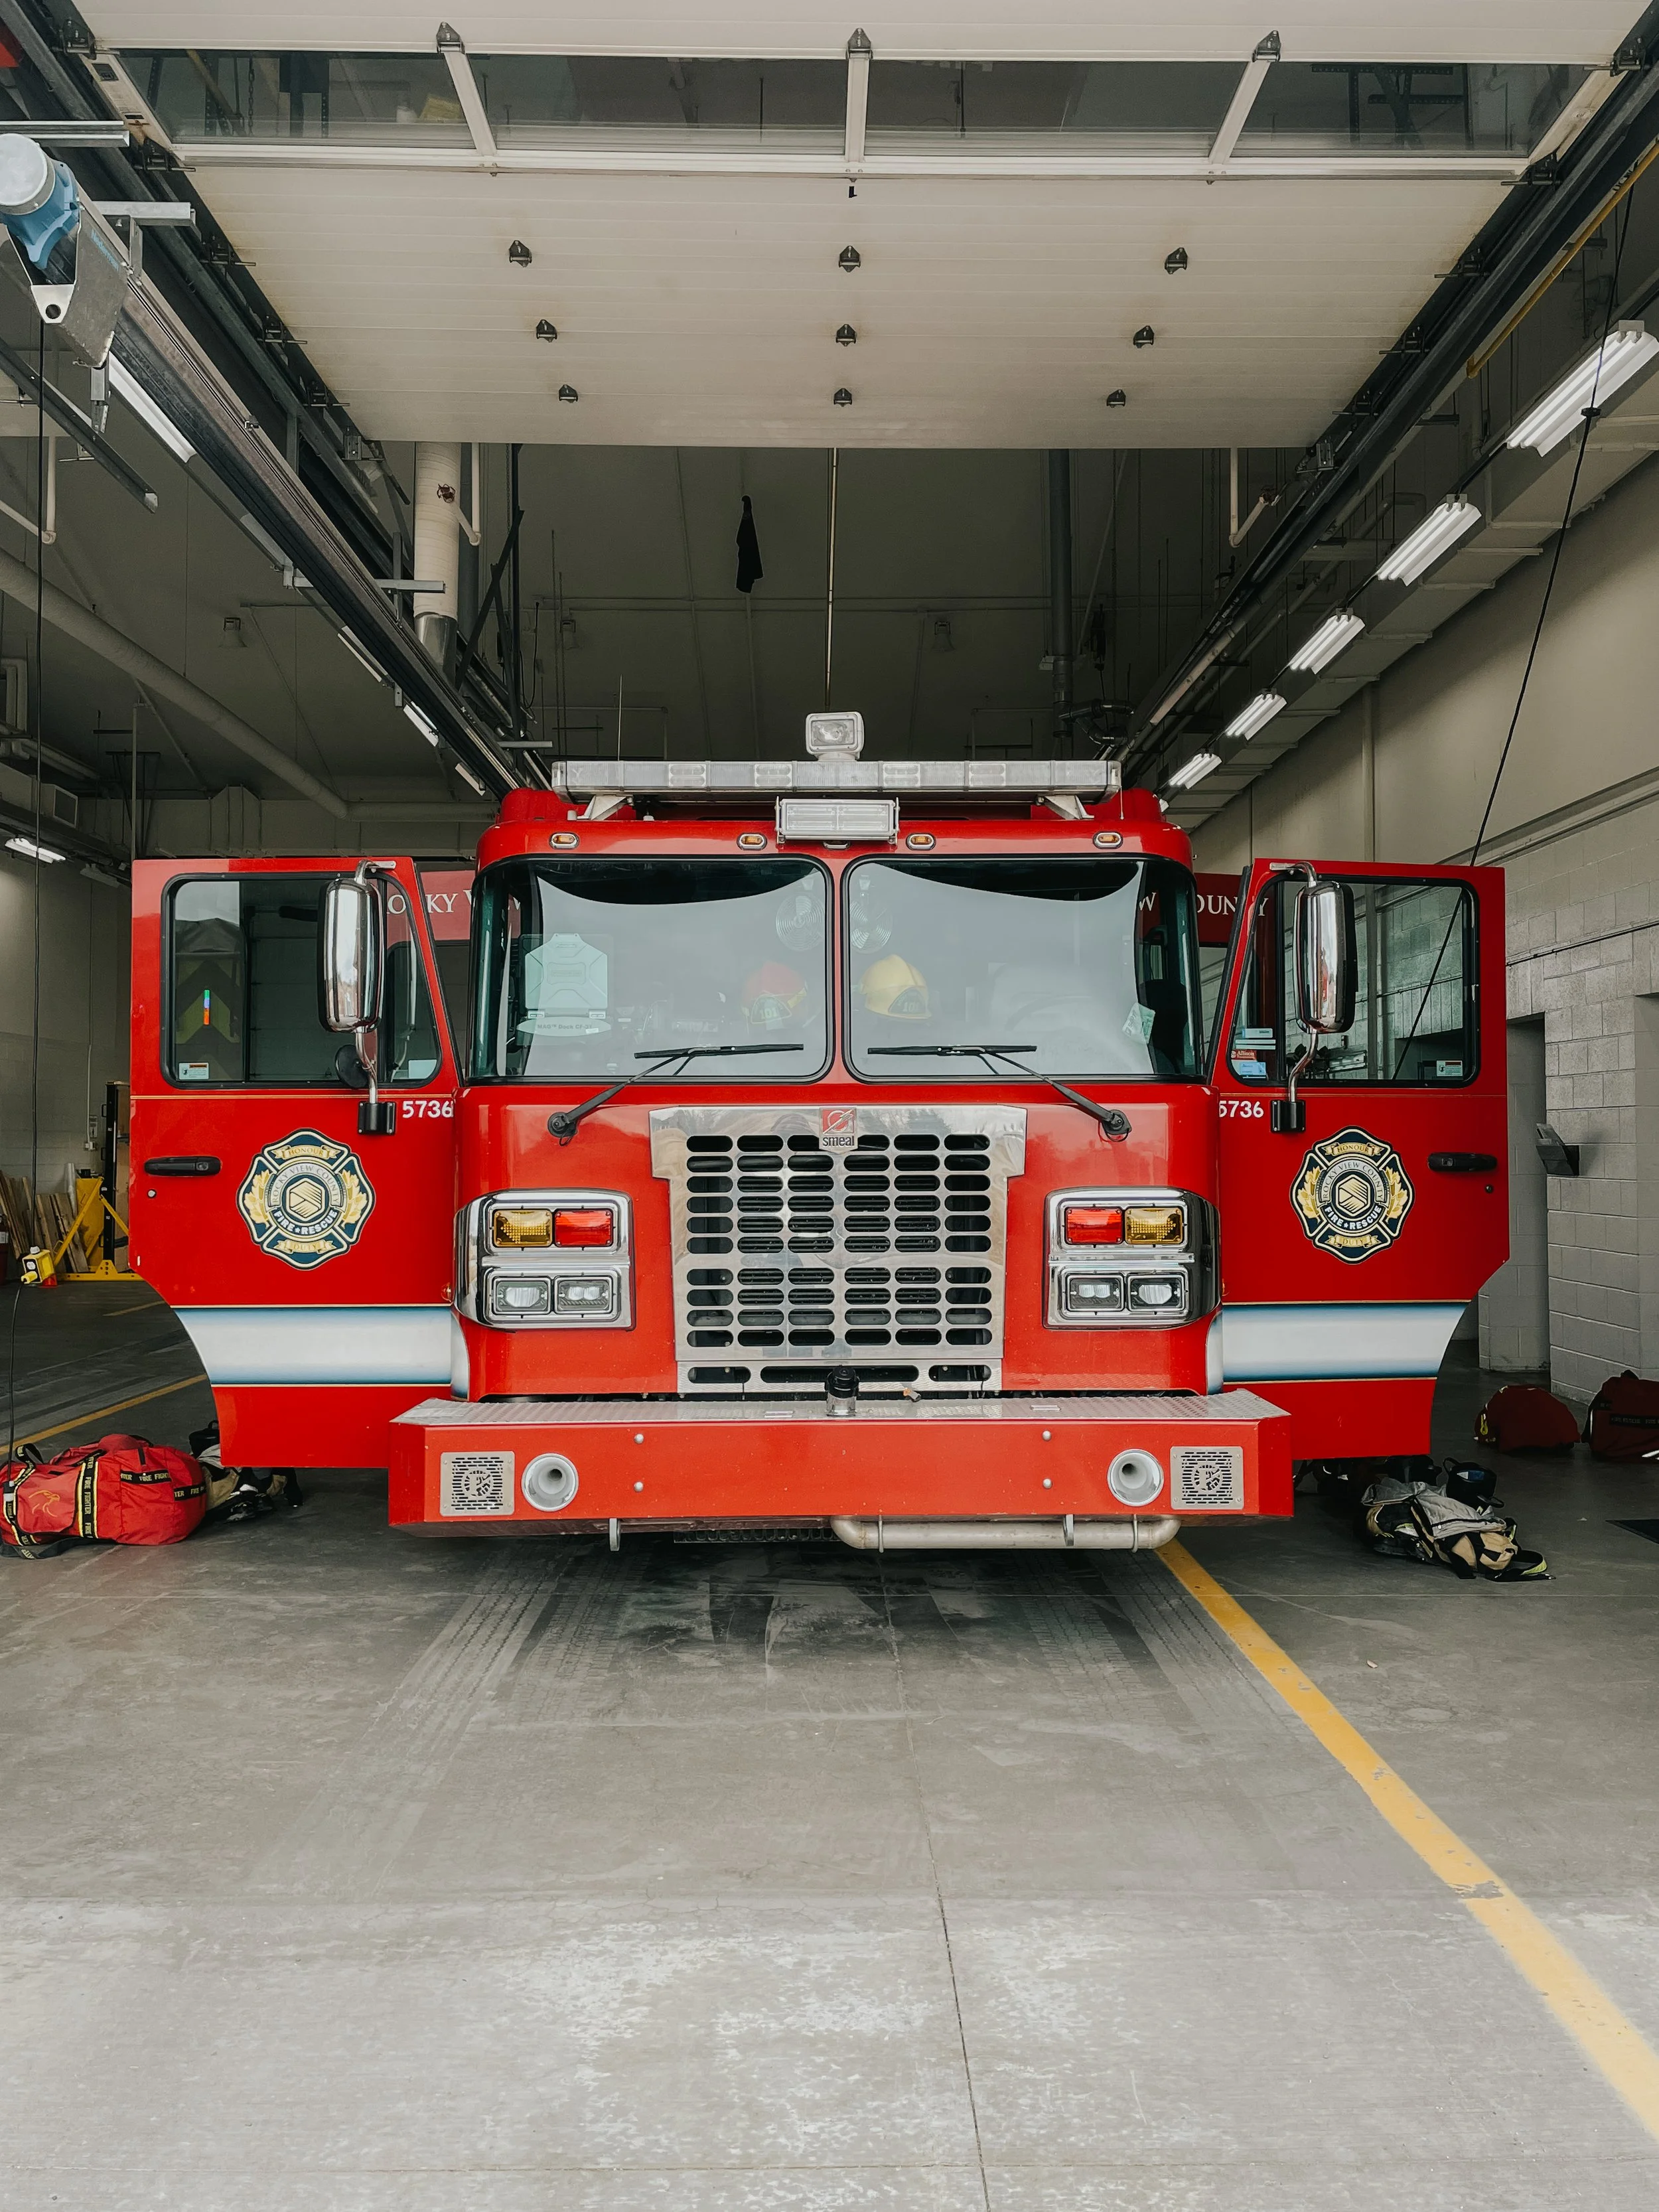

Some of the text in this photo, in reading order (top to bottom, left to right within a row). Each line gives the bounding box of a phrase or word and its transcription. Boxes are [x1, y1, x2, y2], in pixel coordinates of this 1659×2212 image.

[402, 1100, 453, 1118] 5736
[1219, 1100, 1264, 1118] 5736
[823, 1136, 855, 1147] smeal
[1336, 1145, 1369, 1153] HONOUR
[288, 1147, 324, 1156] HONOUR
[273, 1164, 339, 1204] ROCKY VIEW COUNTY
[1323, 1161, 1384, 1201] ROCKY VIEW COUNTY
[273, 1209, 338, 1235] FIRE RESCUE
[1324, 1205, 1382, 1230] FIRE RESCUE
